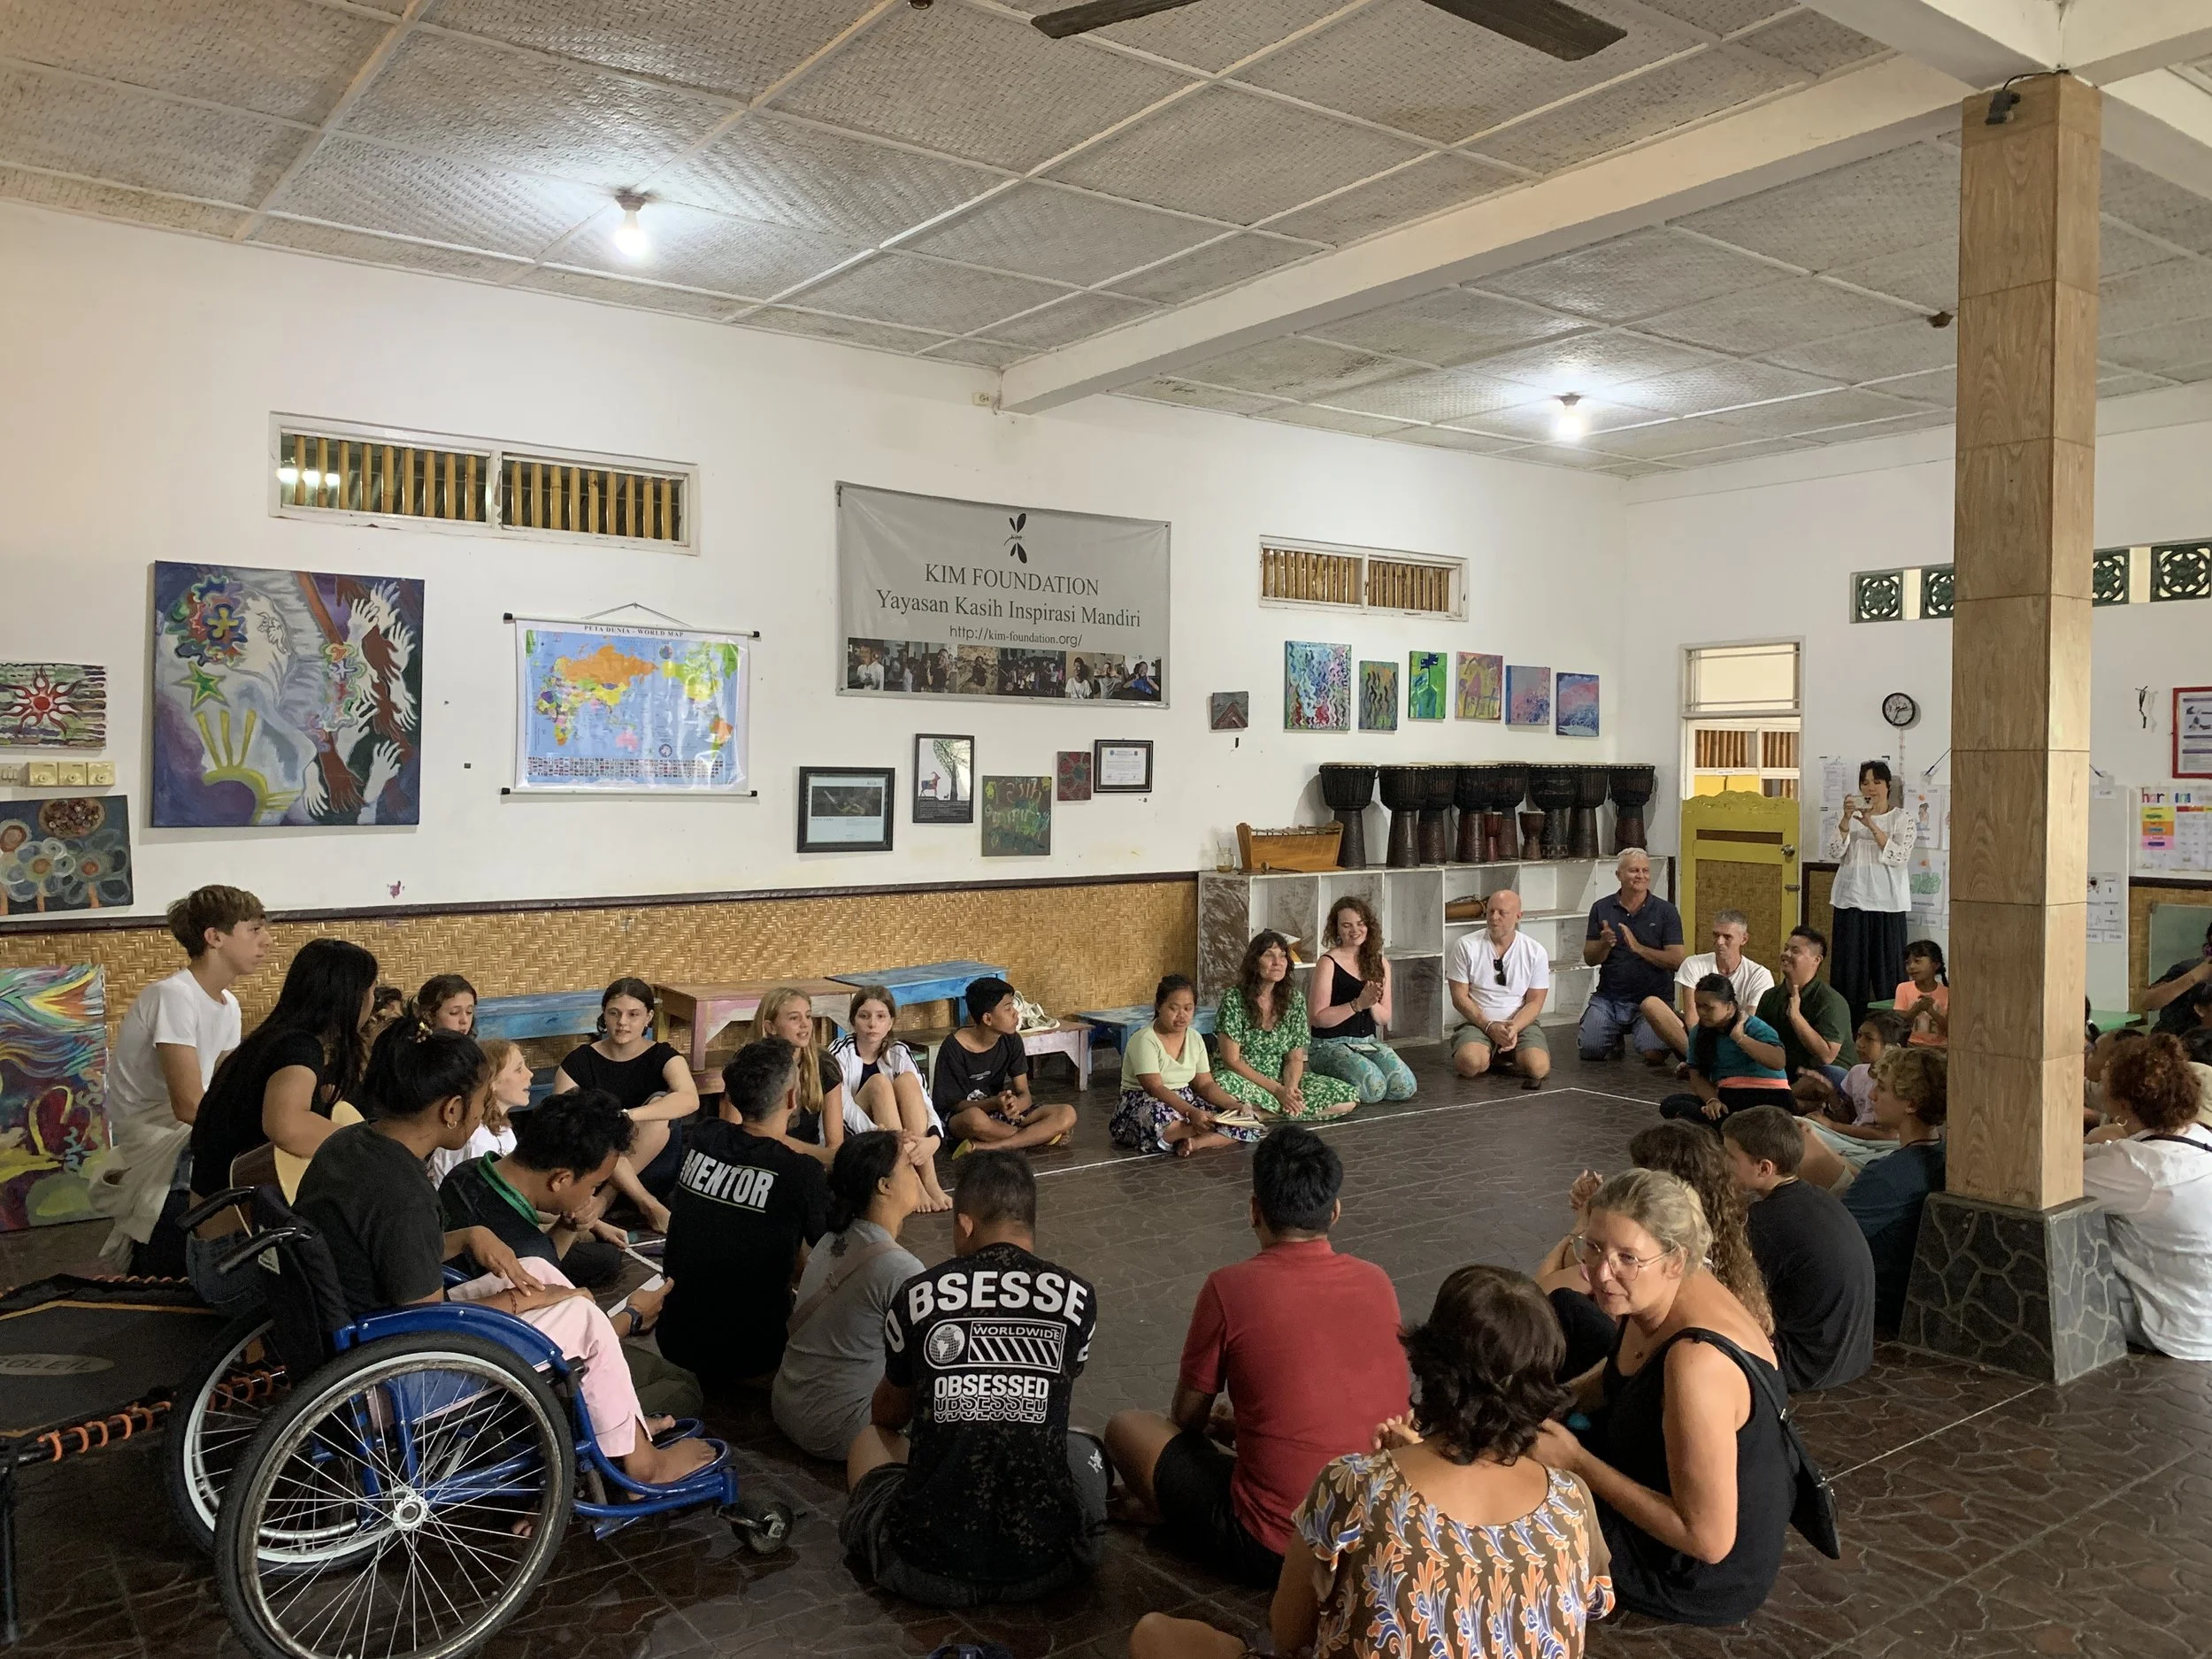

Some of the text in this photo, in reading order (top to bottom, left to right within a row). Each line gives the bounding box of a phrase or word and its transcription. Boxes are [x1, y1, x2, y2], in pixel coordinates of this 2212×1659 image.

[926, 564, 1100, 596] KIM FOUNDATION
[876, 589, 1141, 627] Yayasan Kasih Inspirasi Mandiri
[949, 625, 1083, 648] http://kim-foundation.org/
[680, 1148, 774, 1209] MENTOR
[974, 1326, 1061, 1340] WORLDWIDE
[934, 1374, 1049, 1399] OBSESSED
